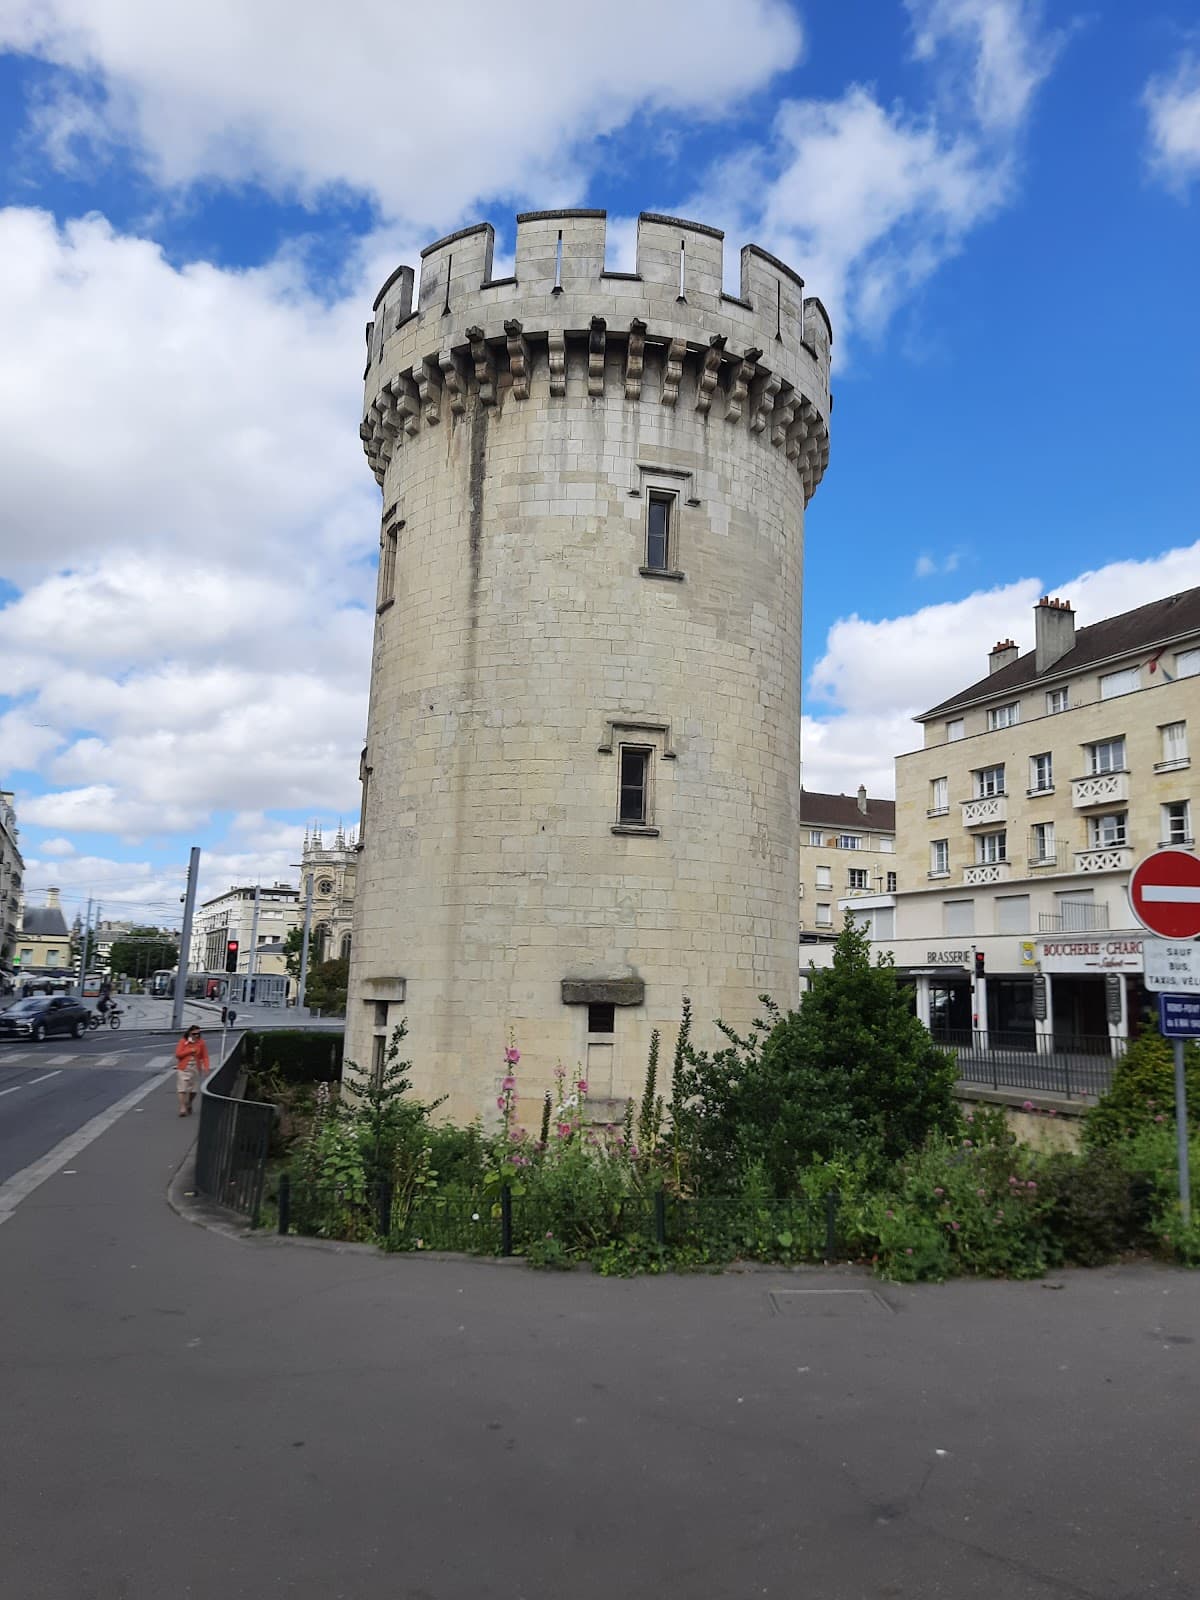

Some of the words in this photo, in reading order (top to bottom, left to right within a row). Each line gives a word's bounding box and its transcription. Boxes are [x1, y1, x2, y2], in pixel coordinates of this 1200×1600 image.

[1044, 943, 1100, 956] BOUCHERIE
[1166, 947, 1192, 956] SAUF
[927, 950, 970, 963] BRASSERIE
[1182, 976, 1200, 986] VÉL
